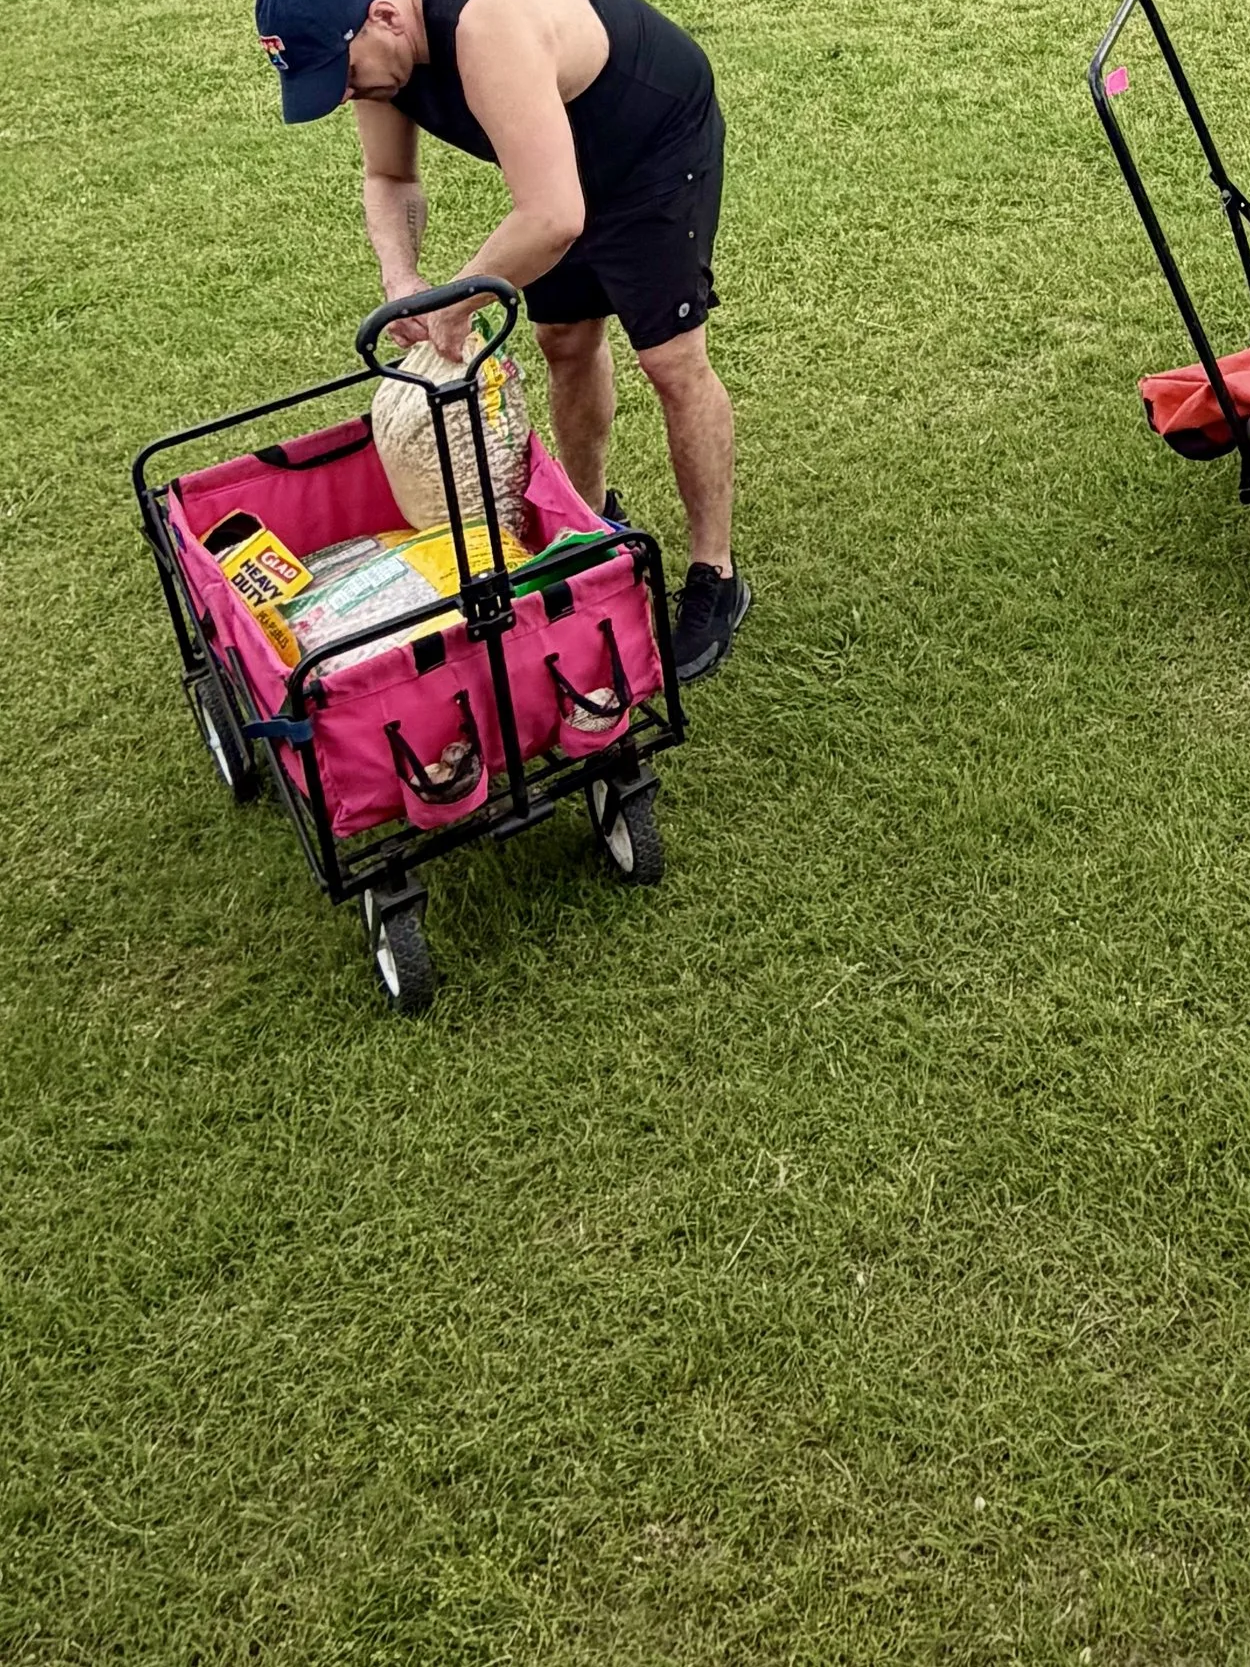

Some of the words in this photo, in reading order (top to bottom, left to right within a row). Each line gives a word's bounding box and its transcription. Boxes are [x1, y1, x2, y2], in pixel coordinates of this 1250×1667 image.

[240, 559, 283, 599] HEAVY
[260, 551, 298, 579] GLAD
[231, 573, 268, 607] DUTY
